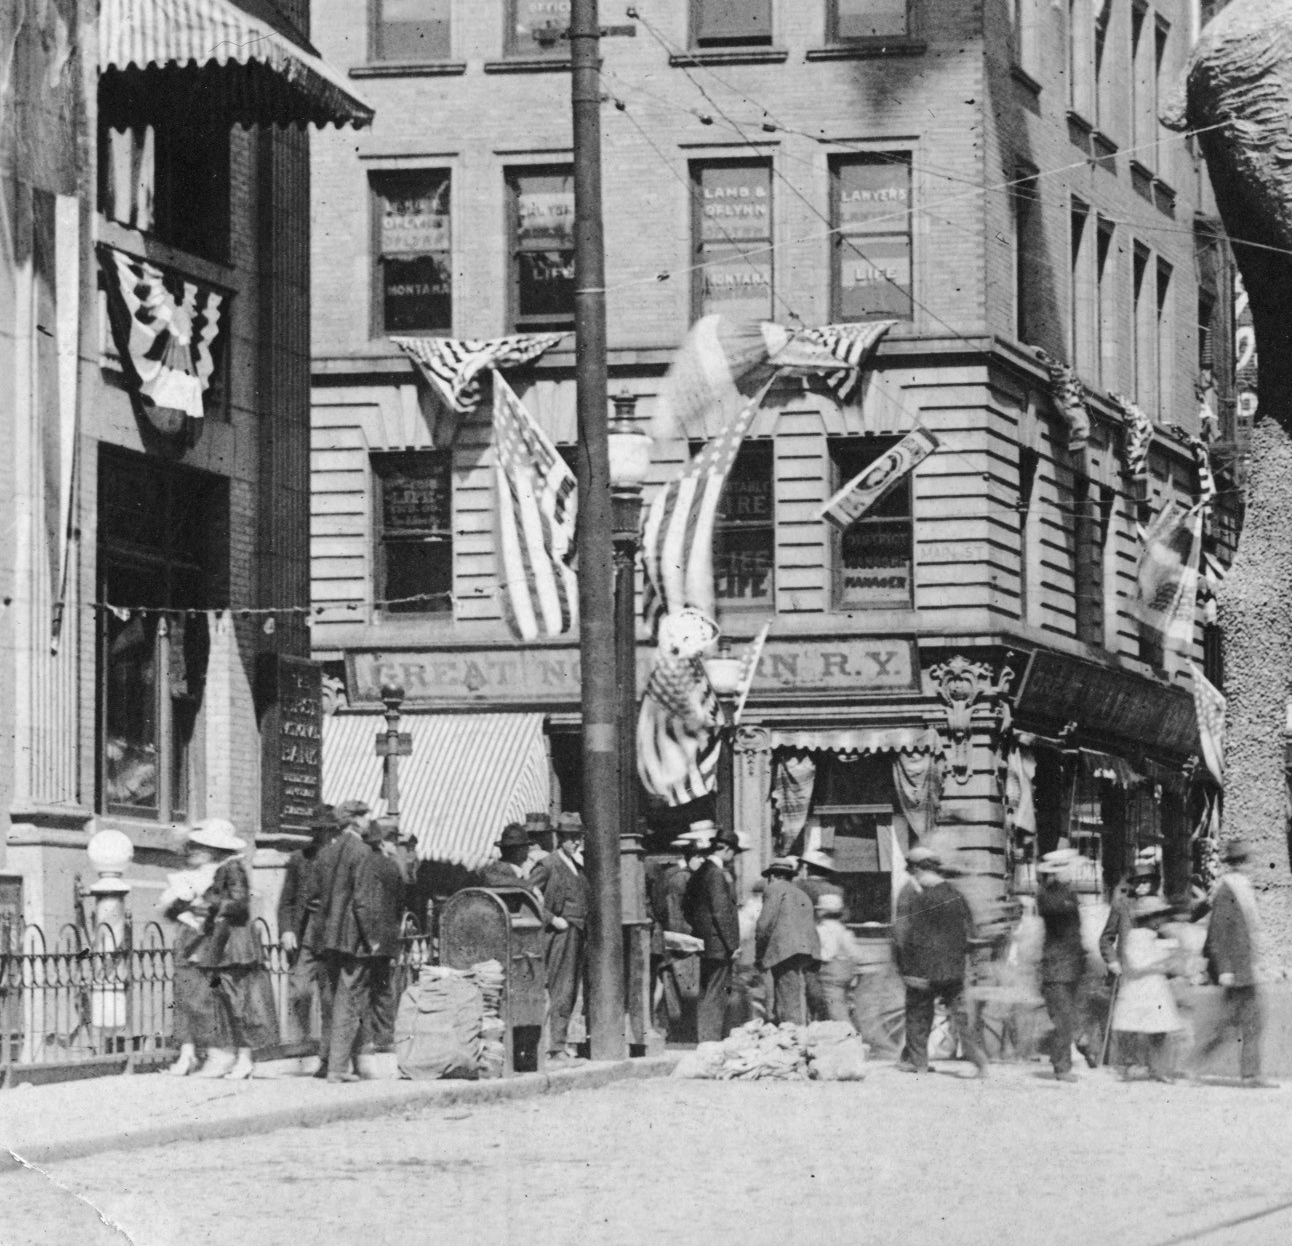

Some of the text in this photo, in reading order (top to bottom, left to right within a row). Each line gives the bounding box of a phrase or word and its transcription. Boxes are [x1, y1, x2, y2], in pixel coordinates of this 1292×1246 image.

[703, 186, 750, 199] LAMB
[842, 188, 908, 202] LAWYERS
[855, 267, 897, 283] LIFE
[373, 659, 515, 688] GREAT
